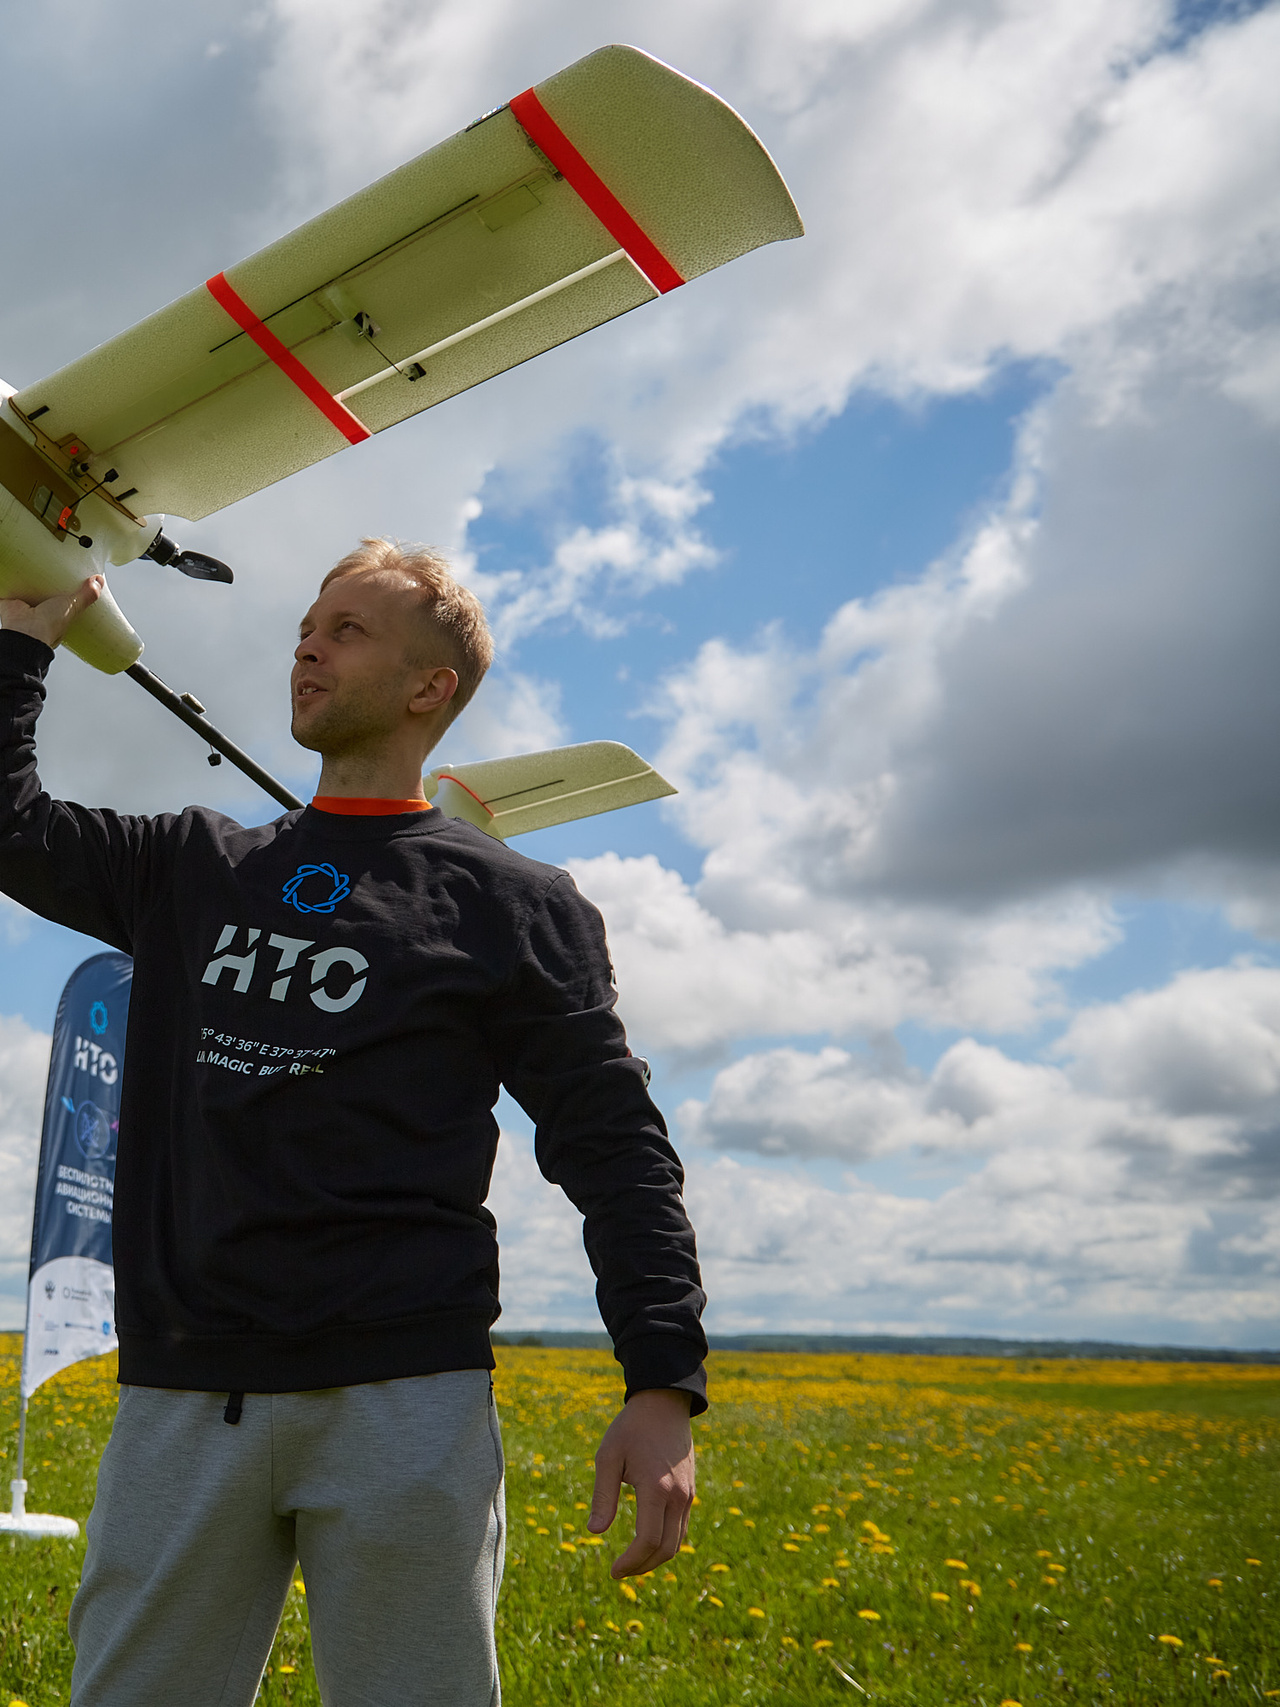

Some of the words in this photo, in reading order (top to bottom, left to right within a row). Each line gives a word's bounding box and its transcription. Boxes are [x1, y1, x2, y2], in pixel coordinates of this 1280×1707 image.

[201, 924, 370, 1013] НТО
[74, 1035, 119, 1085] НТО
[206, 1050, 254, 1075] MAGIC
[258, 1064, 287, 1076] BUT
[56, 1164, 115, 1194] БЕСПИЛОТН
[54, 1181, 114, 1211] АВИАЦИОНН
